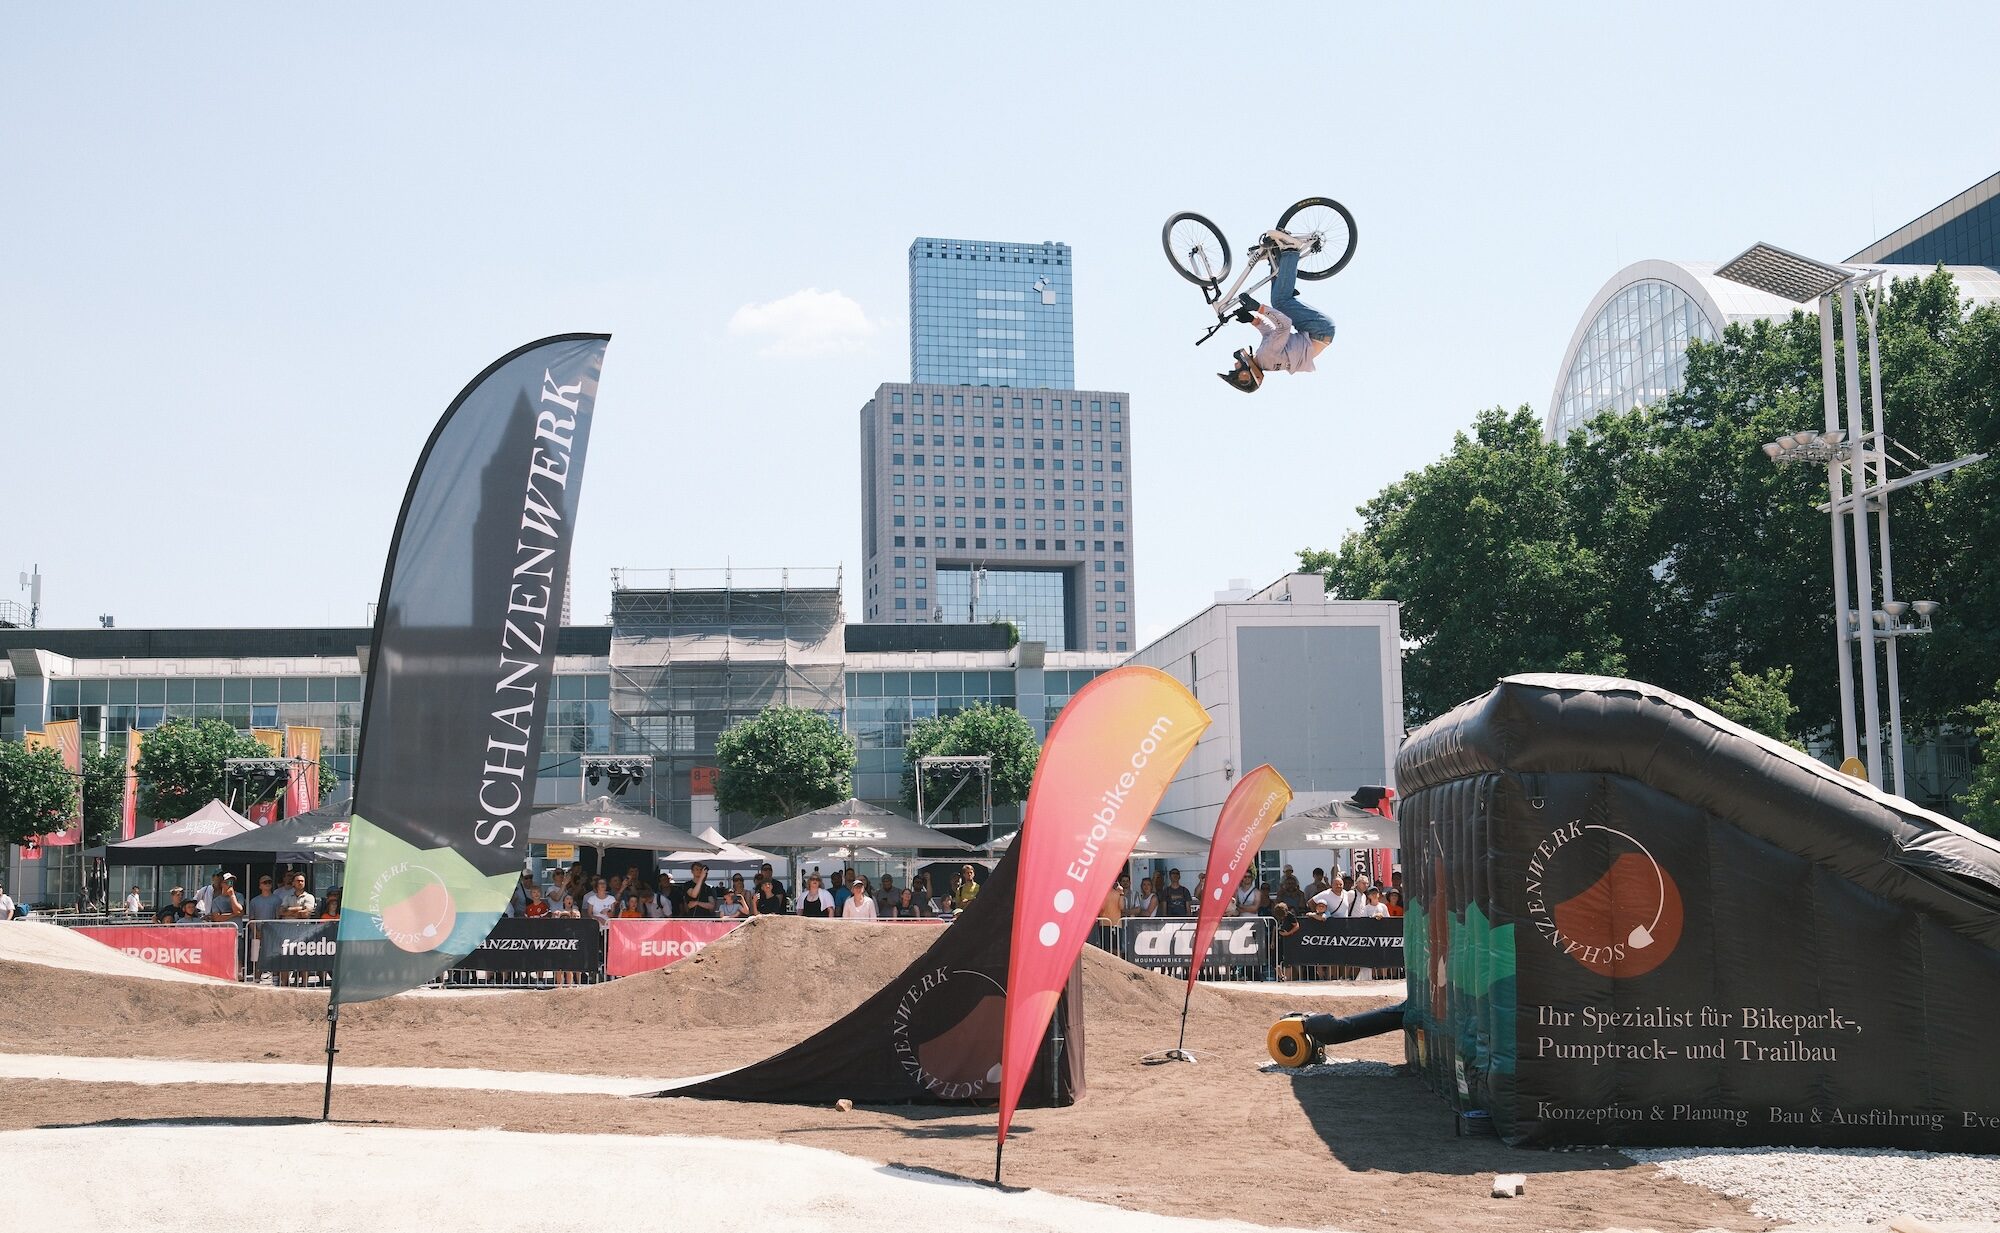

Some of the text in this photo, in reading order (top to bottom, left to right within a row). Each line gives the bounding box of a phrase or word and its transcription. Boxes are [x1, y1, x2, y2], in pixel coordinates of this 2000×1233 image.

[474, 367, 582, 849] SCHANZENWERK
[1066, 715, 1174, 883] Eurobike.com
[369, 861, 422, 944] SCHANZENWERK
[1526, 819, 1625, 964] SCHANZENWERK
[281, 937, 337, 956] freedo
[475, 938, 579, 951] ANZENWERK
[893, 965, 983, 1098] SCHANZENWERK
[1539, 1006, 1861, 1035] Ihr Spezialist für Bikepark-,
[1538, 1037, 1836, 1065] Pumptrack- und Trailbau
[1538, 1102, 1642, 1124] Konzeption
[1650, 1105, 1664, 1120] &
[1674, 1105, 1749, 1126] Planung
[1770, 1107, 1803, 1123] Bau
[1810, 1108, 1822, 1122] &
[1831, 1108, 1944, 1130] Ausführung
